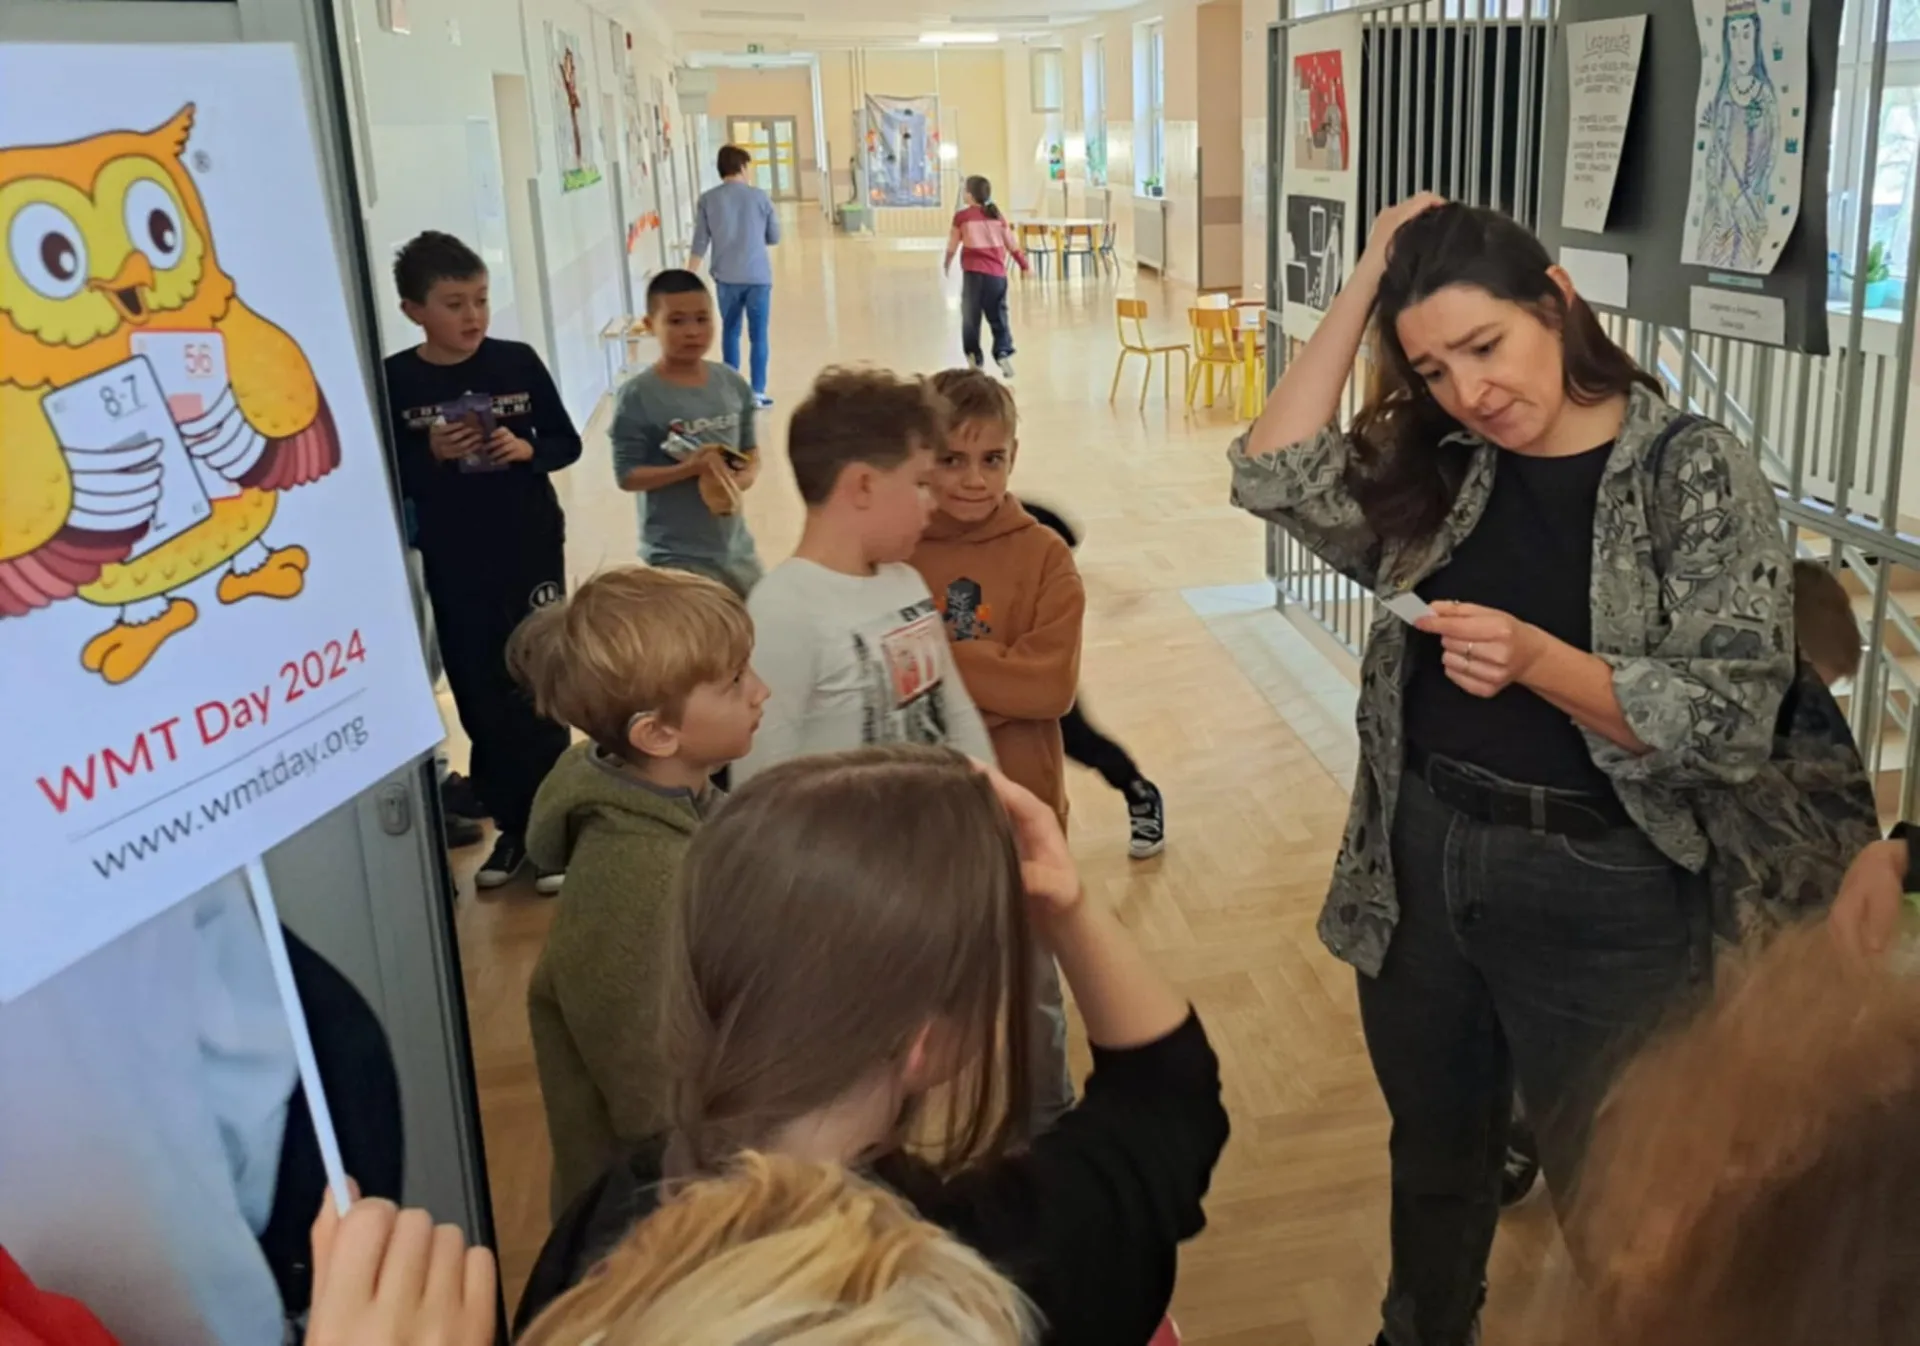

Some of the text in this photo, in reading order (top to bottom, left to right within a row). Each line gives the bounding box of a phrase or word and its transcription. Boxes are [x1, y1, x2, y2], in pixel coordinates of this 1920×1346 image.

[185, 344, 212, 374] 56
[36, 629, 367, 814] WMT Day 2024
[91, 715, 370, 880] www.wmtday.org
